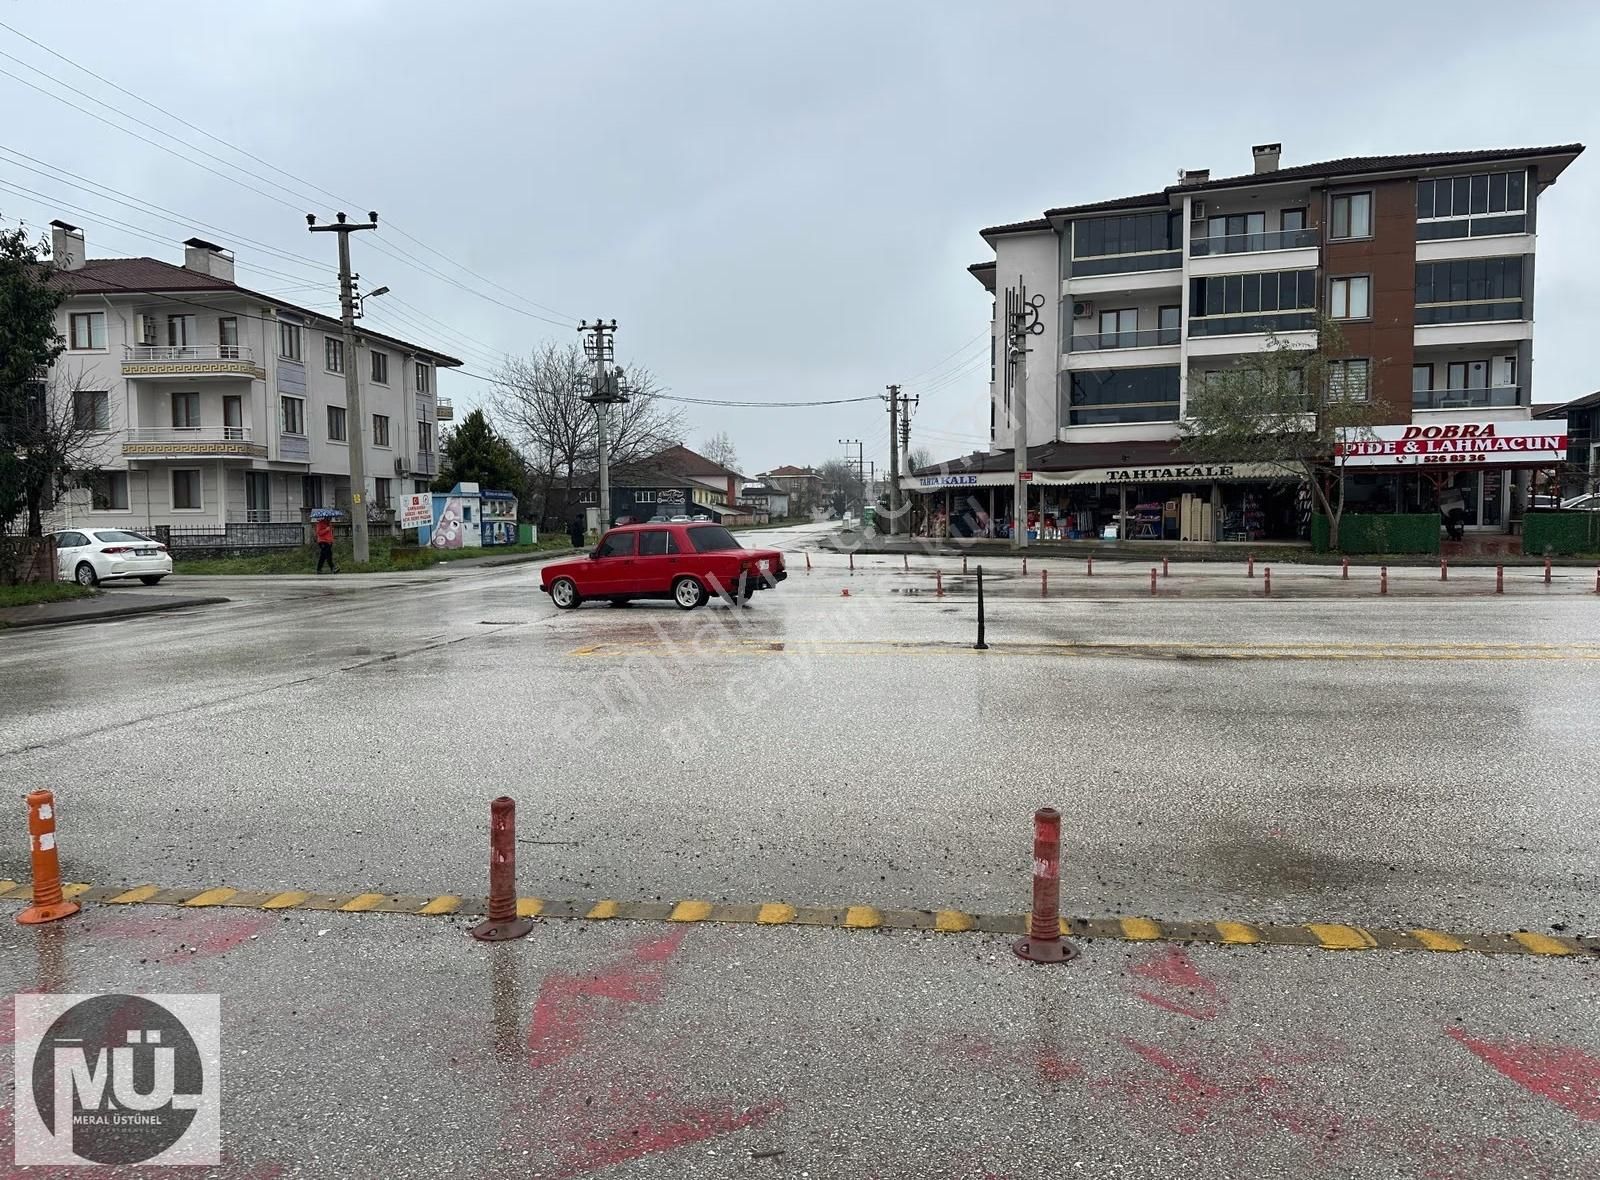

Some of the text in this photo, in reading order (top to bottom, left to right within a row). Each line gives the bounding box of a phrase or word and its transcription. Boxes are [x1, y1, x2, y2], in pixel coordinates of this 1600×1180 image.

[1401, 423, 1496, 440] DOBRA
[1403, 440, 1420, 454] &
[1426, 437, 1560, 453] LAHMACUN
[1424, 454, 1447, 463] 526
[1106, 465, 1234, 481] TAHTAKALE
